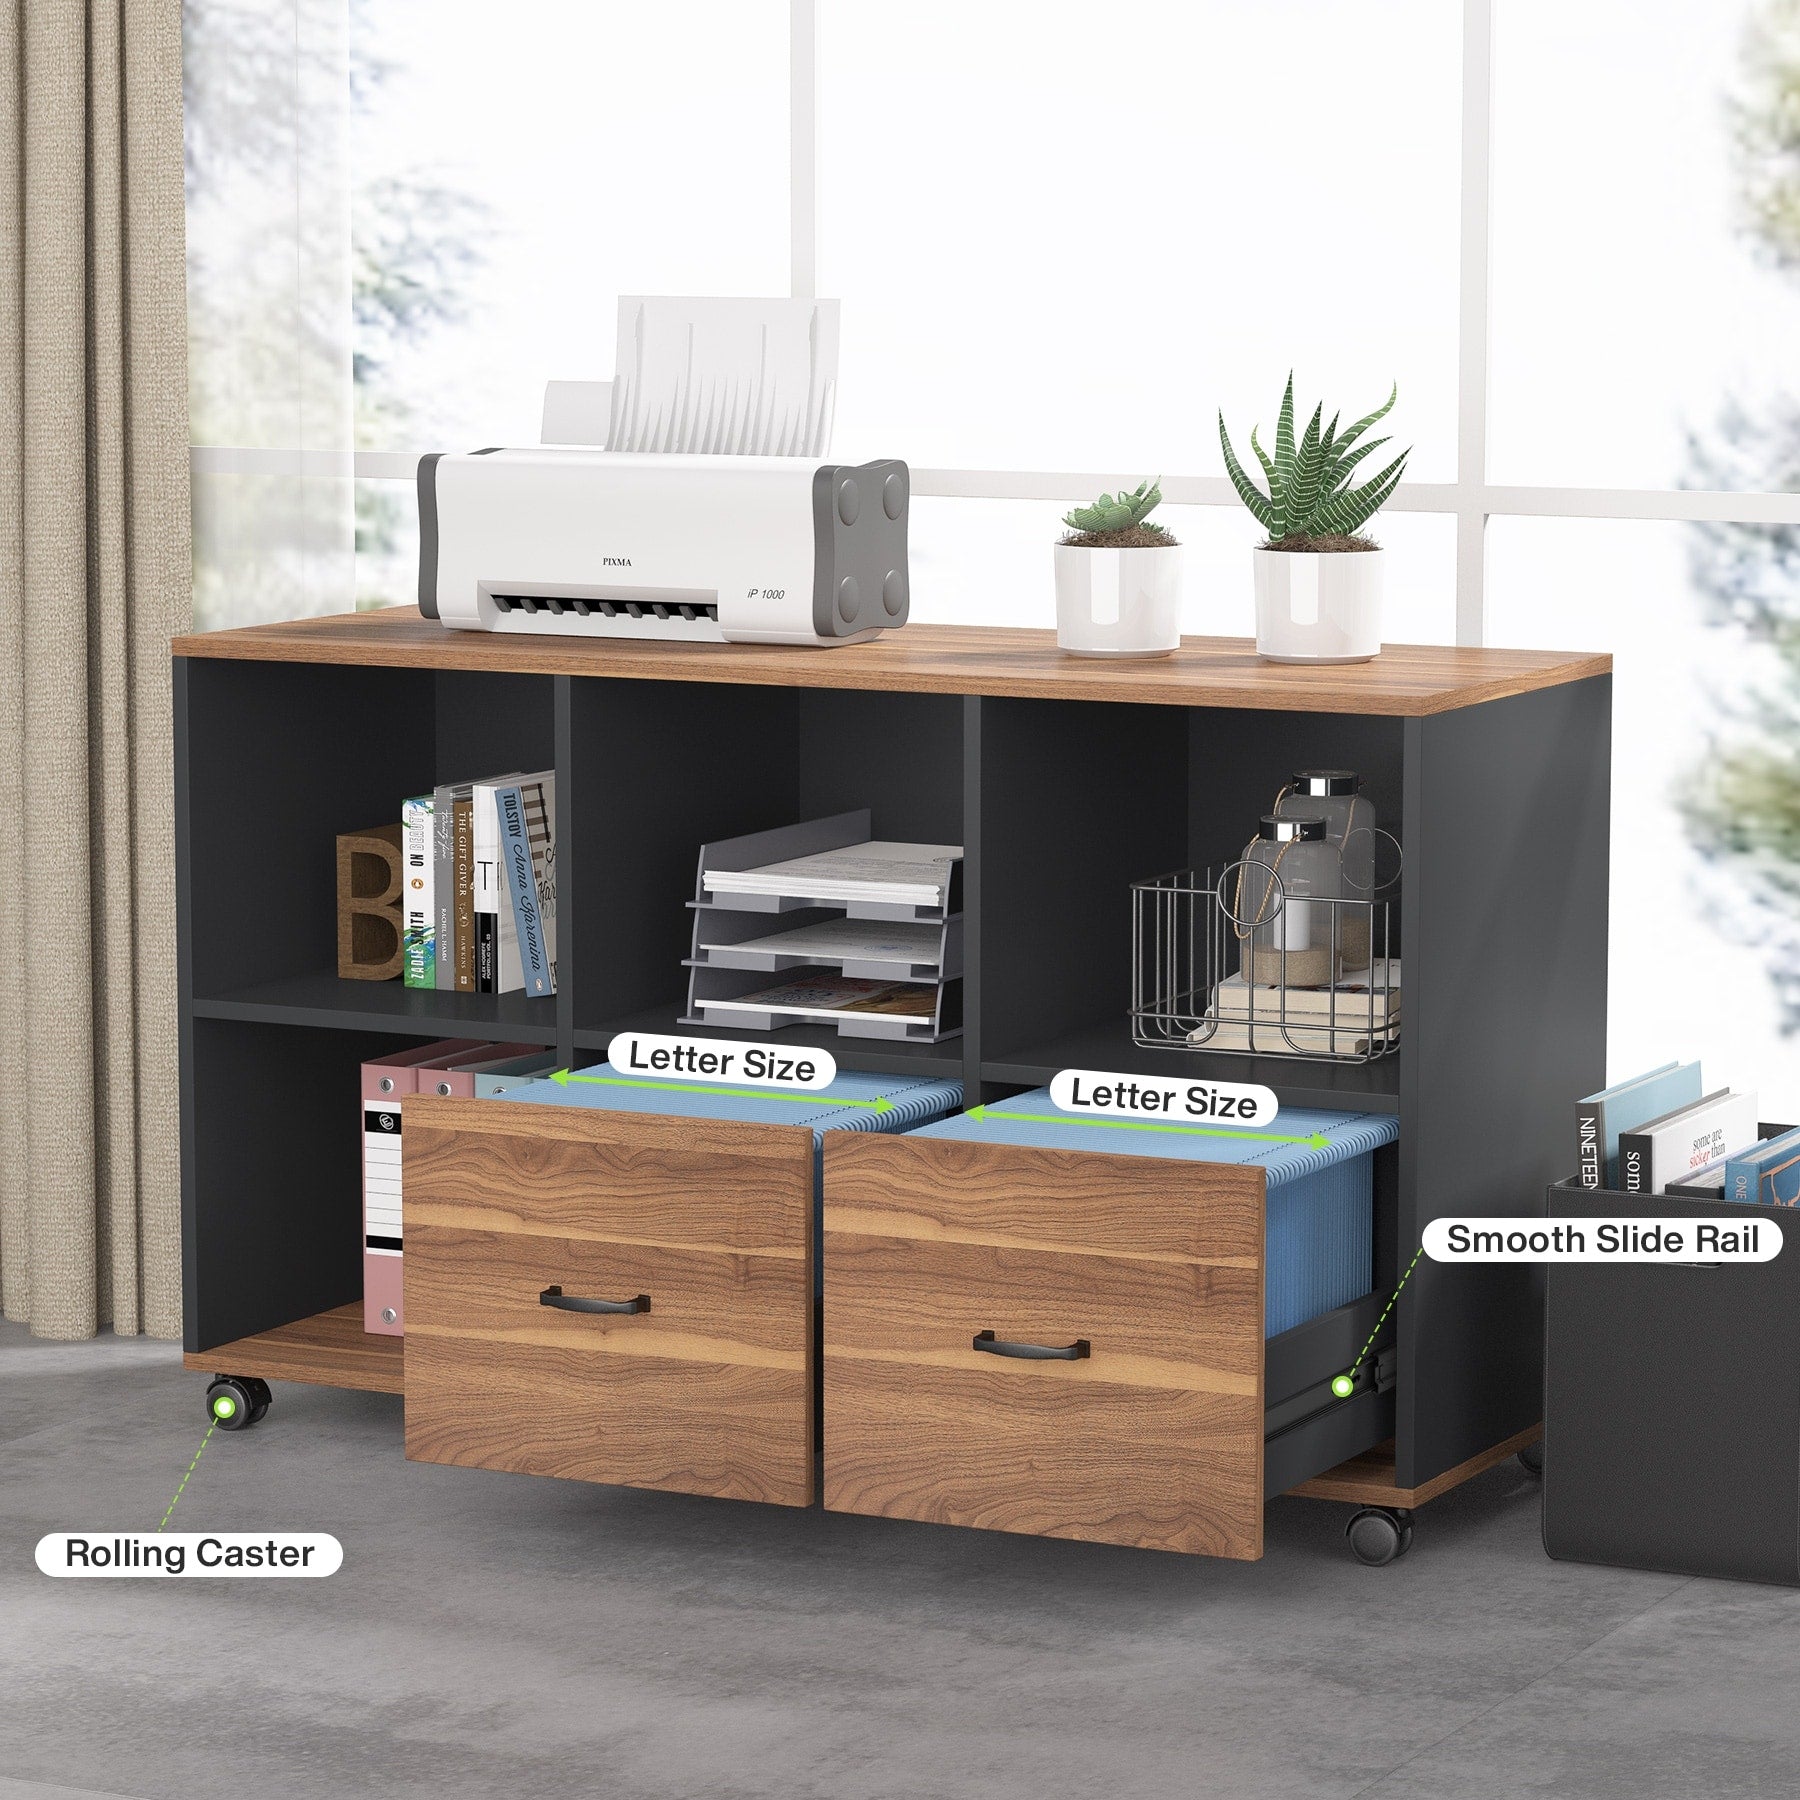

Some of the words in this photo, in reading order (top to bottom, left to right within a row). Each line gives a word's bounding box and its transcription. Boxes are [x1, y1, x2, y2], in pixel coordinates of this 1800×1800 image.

[602, 557, 632, 567] PIXMA
[747, 589, 758, 598] iP
[762, 590, 785, 600] 1000
[459, 811, 467, 832] THE
[503, 793, 522, 837] TOLSTOY
[409, 810, 424, 851] BEAUTY
[410, 854, 424, 867] ON
[459, 836, 467, 861] GIFT
[459, 863, 467, 896] GIVER
[513, 844, 528, 891] Anna
[410, 911, 425, 945] SMITH
[519, 895, 541, 972] Karenina
[410, 949, 425, 979] ZADIE
[1693, 1133, 1710, 1151] some
[1712, 1128, 1722, 1142] are
[1711, 1142, 1726, 1159] than
[1627, 1152, 1640, 1193] som
[1735, 1175, 1747, 1199] ONE
